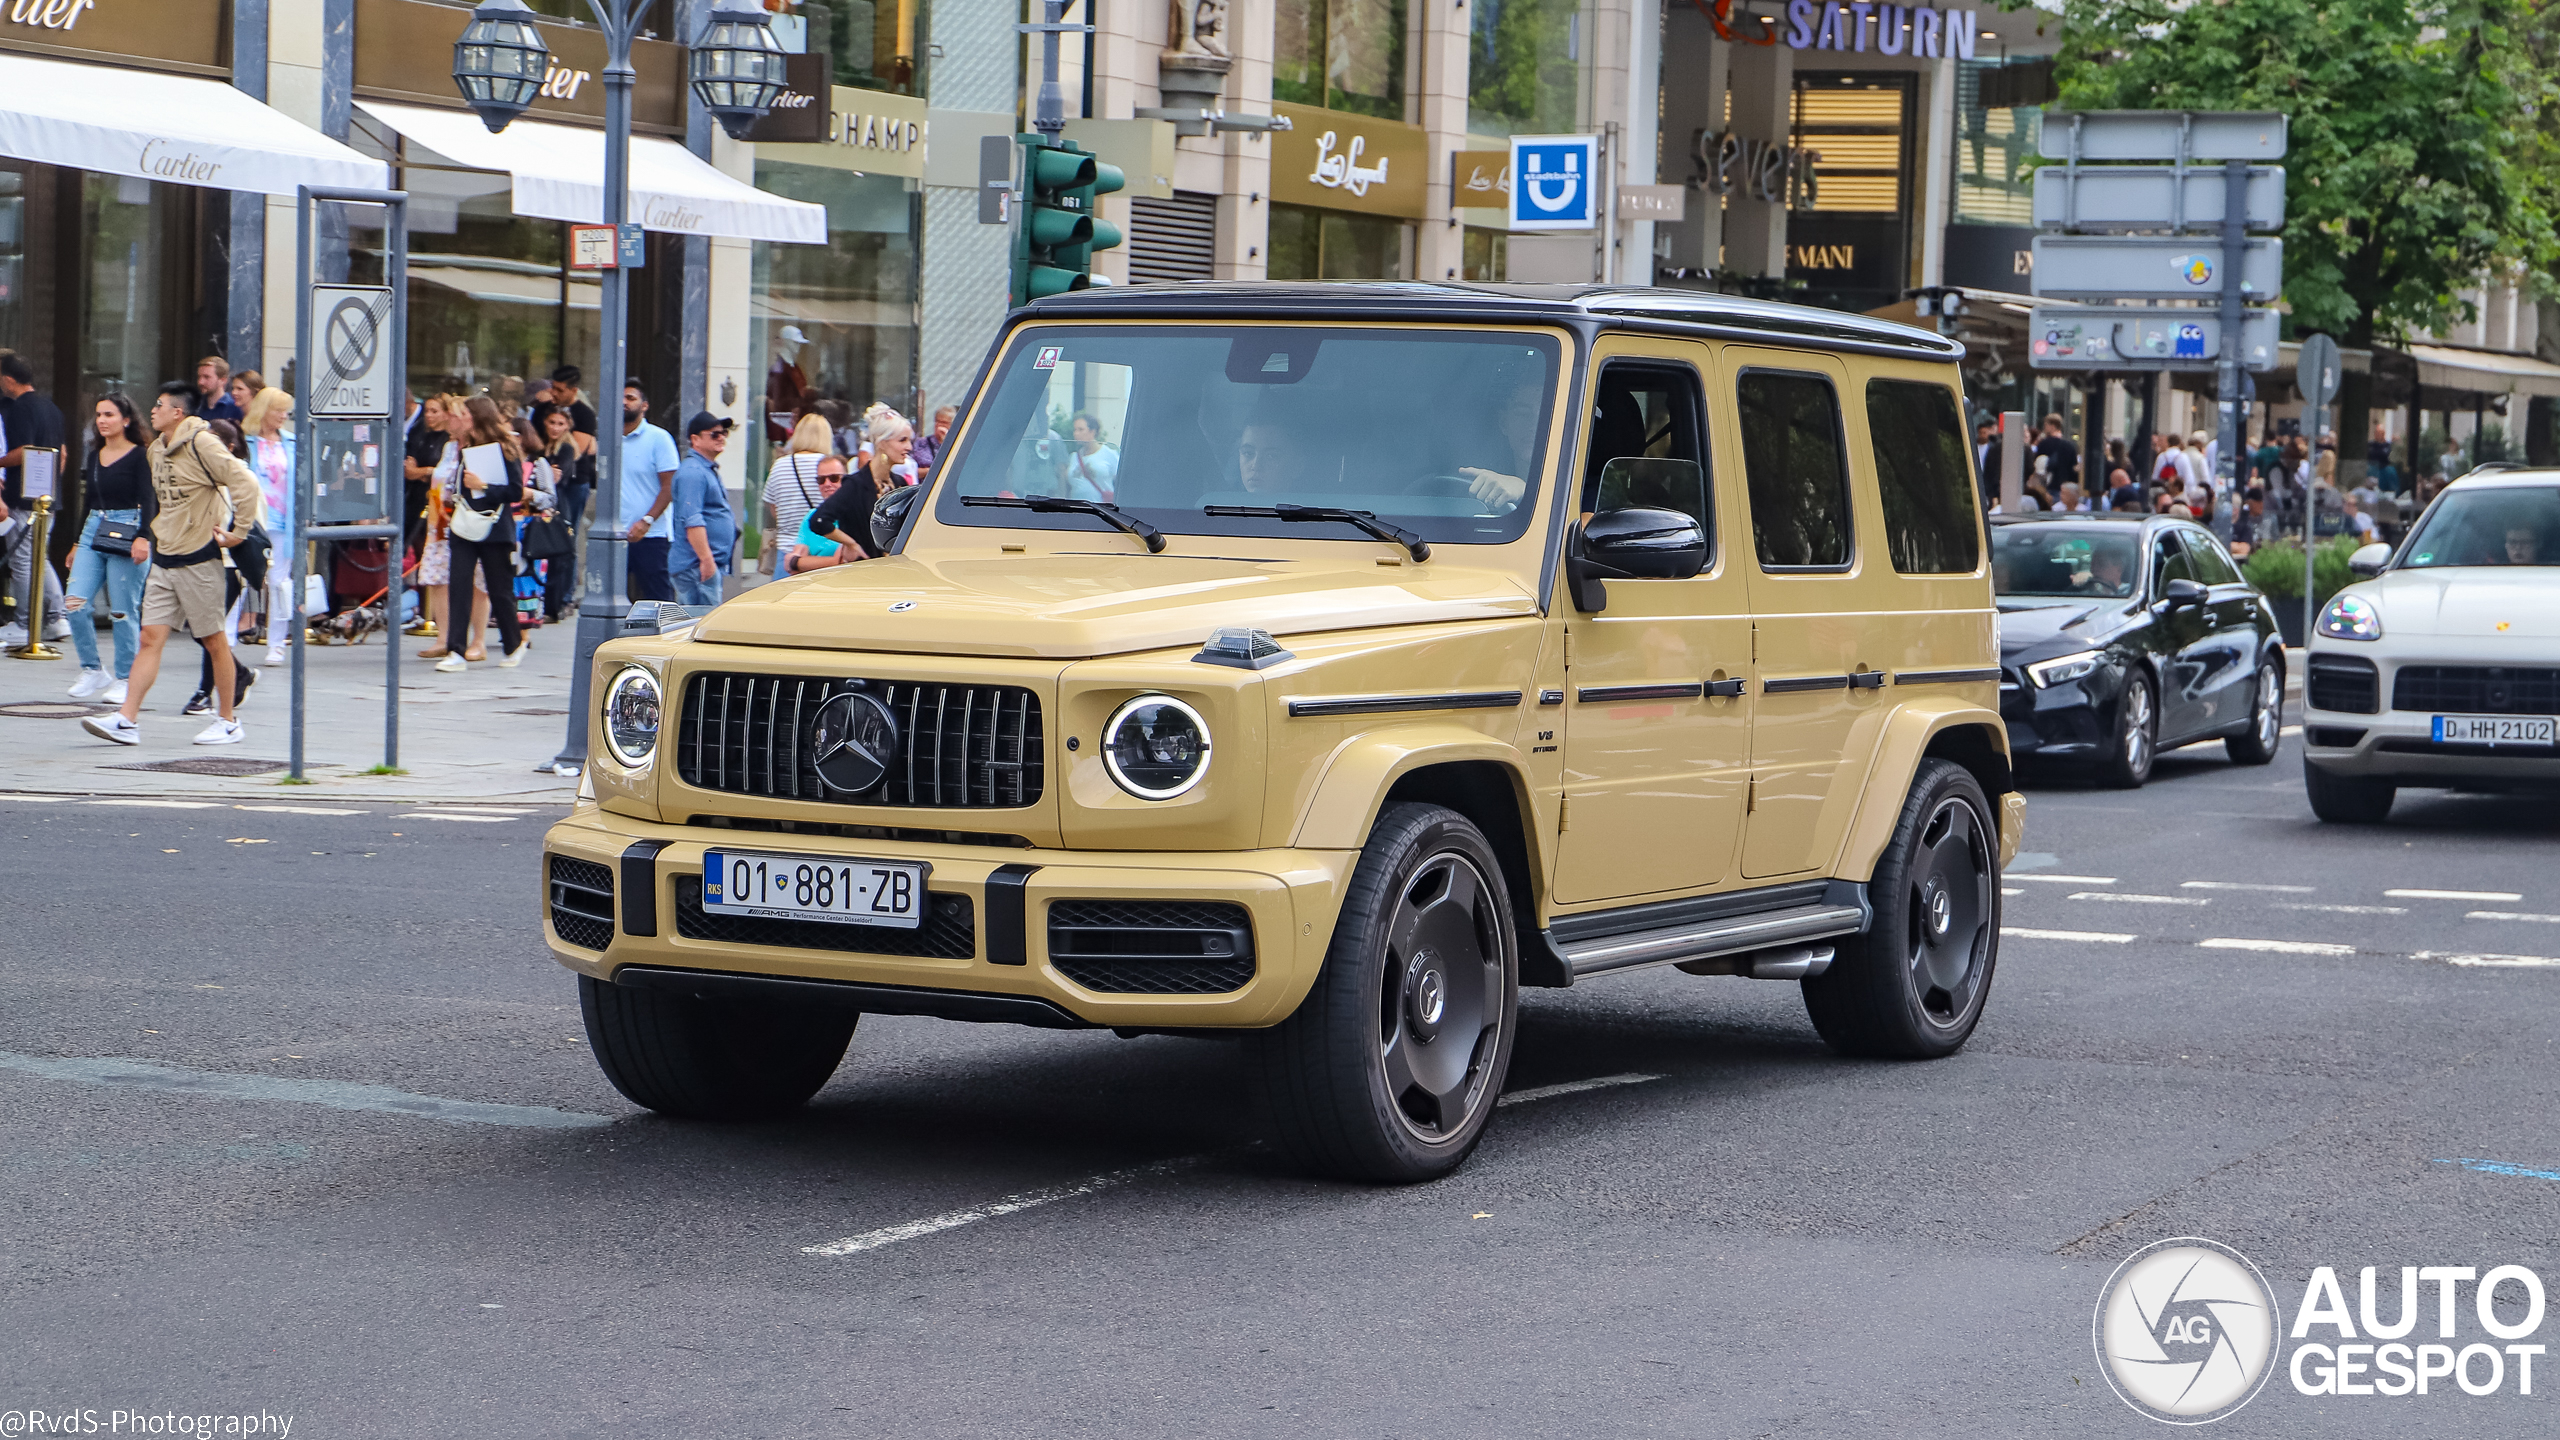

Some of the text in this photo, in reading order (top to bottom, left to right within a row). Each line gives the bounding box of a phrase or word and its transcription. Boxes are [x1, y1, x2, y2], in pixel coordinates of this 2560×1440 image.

[1786, 1, 1977, 60] SATURN
[140, 137, 222, 181] Cartier
[1524, 172, 1581, 181] stadtbahn
[644, 194, 704, 228] Cartier
[330, 387, 371, 407] ZONE
[1538, 730, 1554, 741] V8
[2446, 720, 2549, 740] D HH 2102
[707, 883, 722, 895] RKS
[732, 859, 911, 913] 01 881-ZB
[793, 912, 825, 921] Performance
